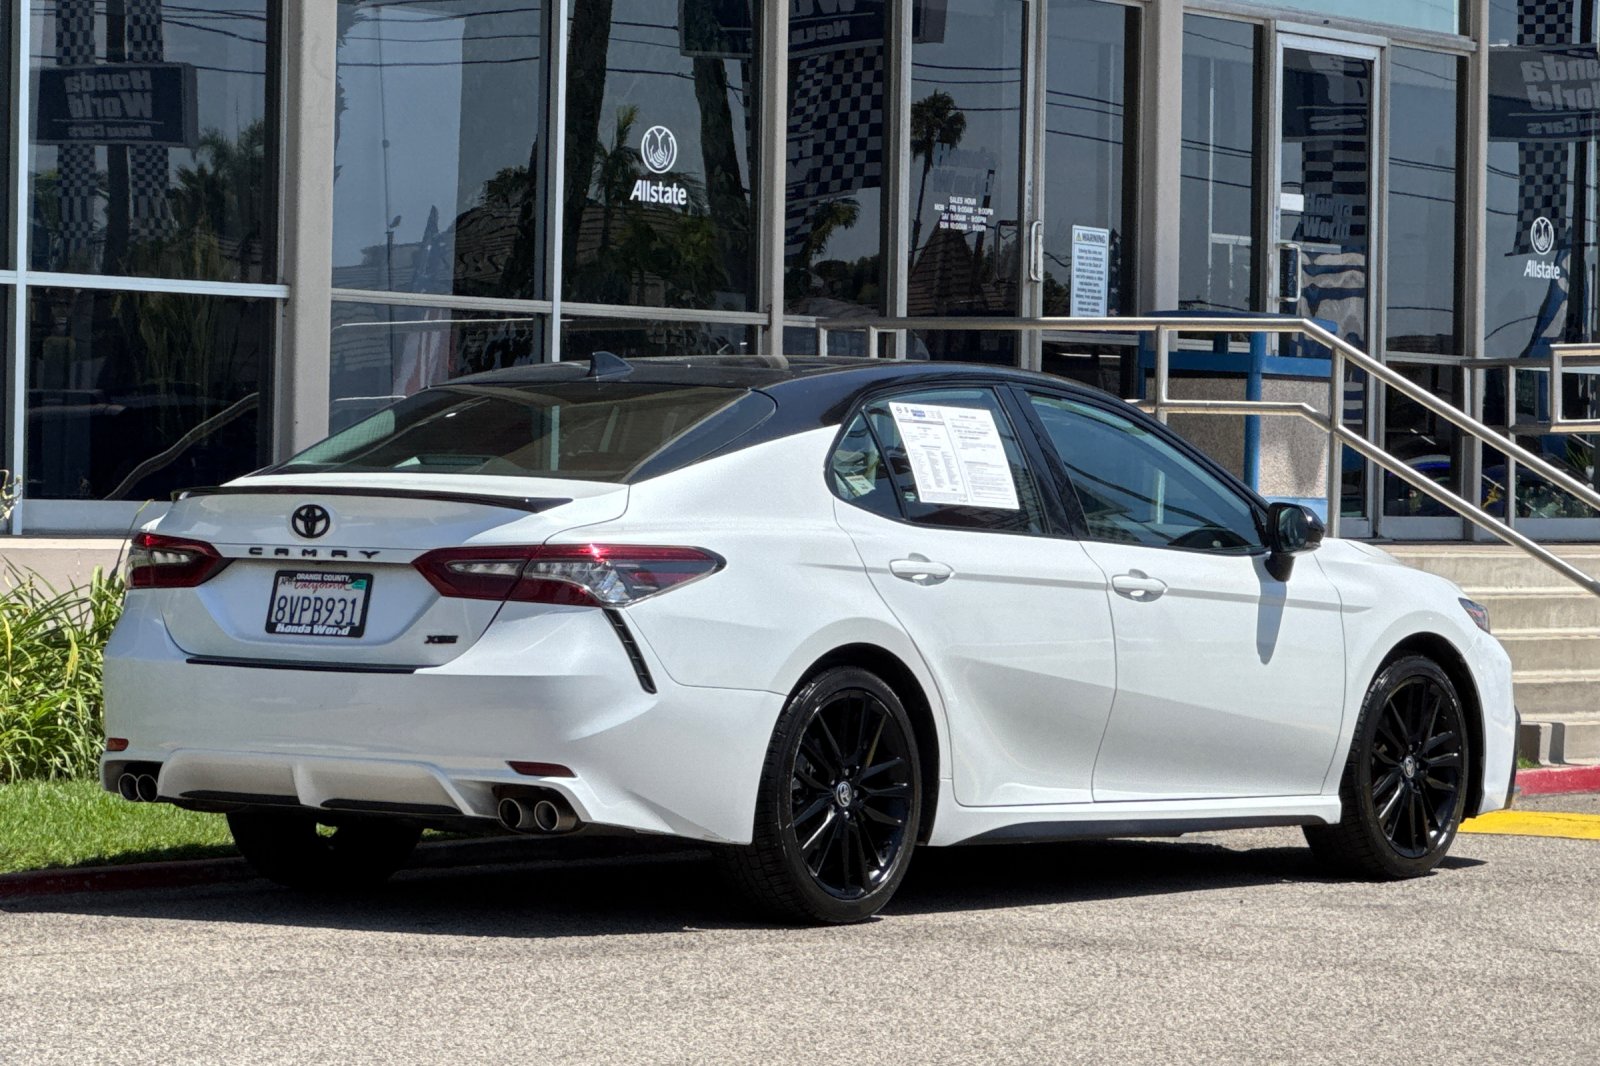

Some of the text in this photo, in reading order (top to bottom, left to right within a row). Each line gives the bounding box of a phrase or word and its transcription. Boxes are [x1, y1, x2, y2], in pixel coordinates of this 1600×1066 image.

[629, 179, 687, 205] Allstate
[949, 196, 976, 205] SALES HOUR
[1082, 233, 1106, 243] WARNING
[1523, 259, 1560, 279] Allstate
[249, 547, 380, 559] CAMRY
[296, 573, 350, 582] ORANGE COUNTY
[275, 595, 357, 626] 8VPB931
[275, 623, 351, 636] Honda World
